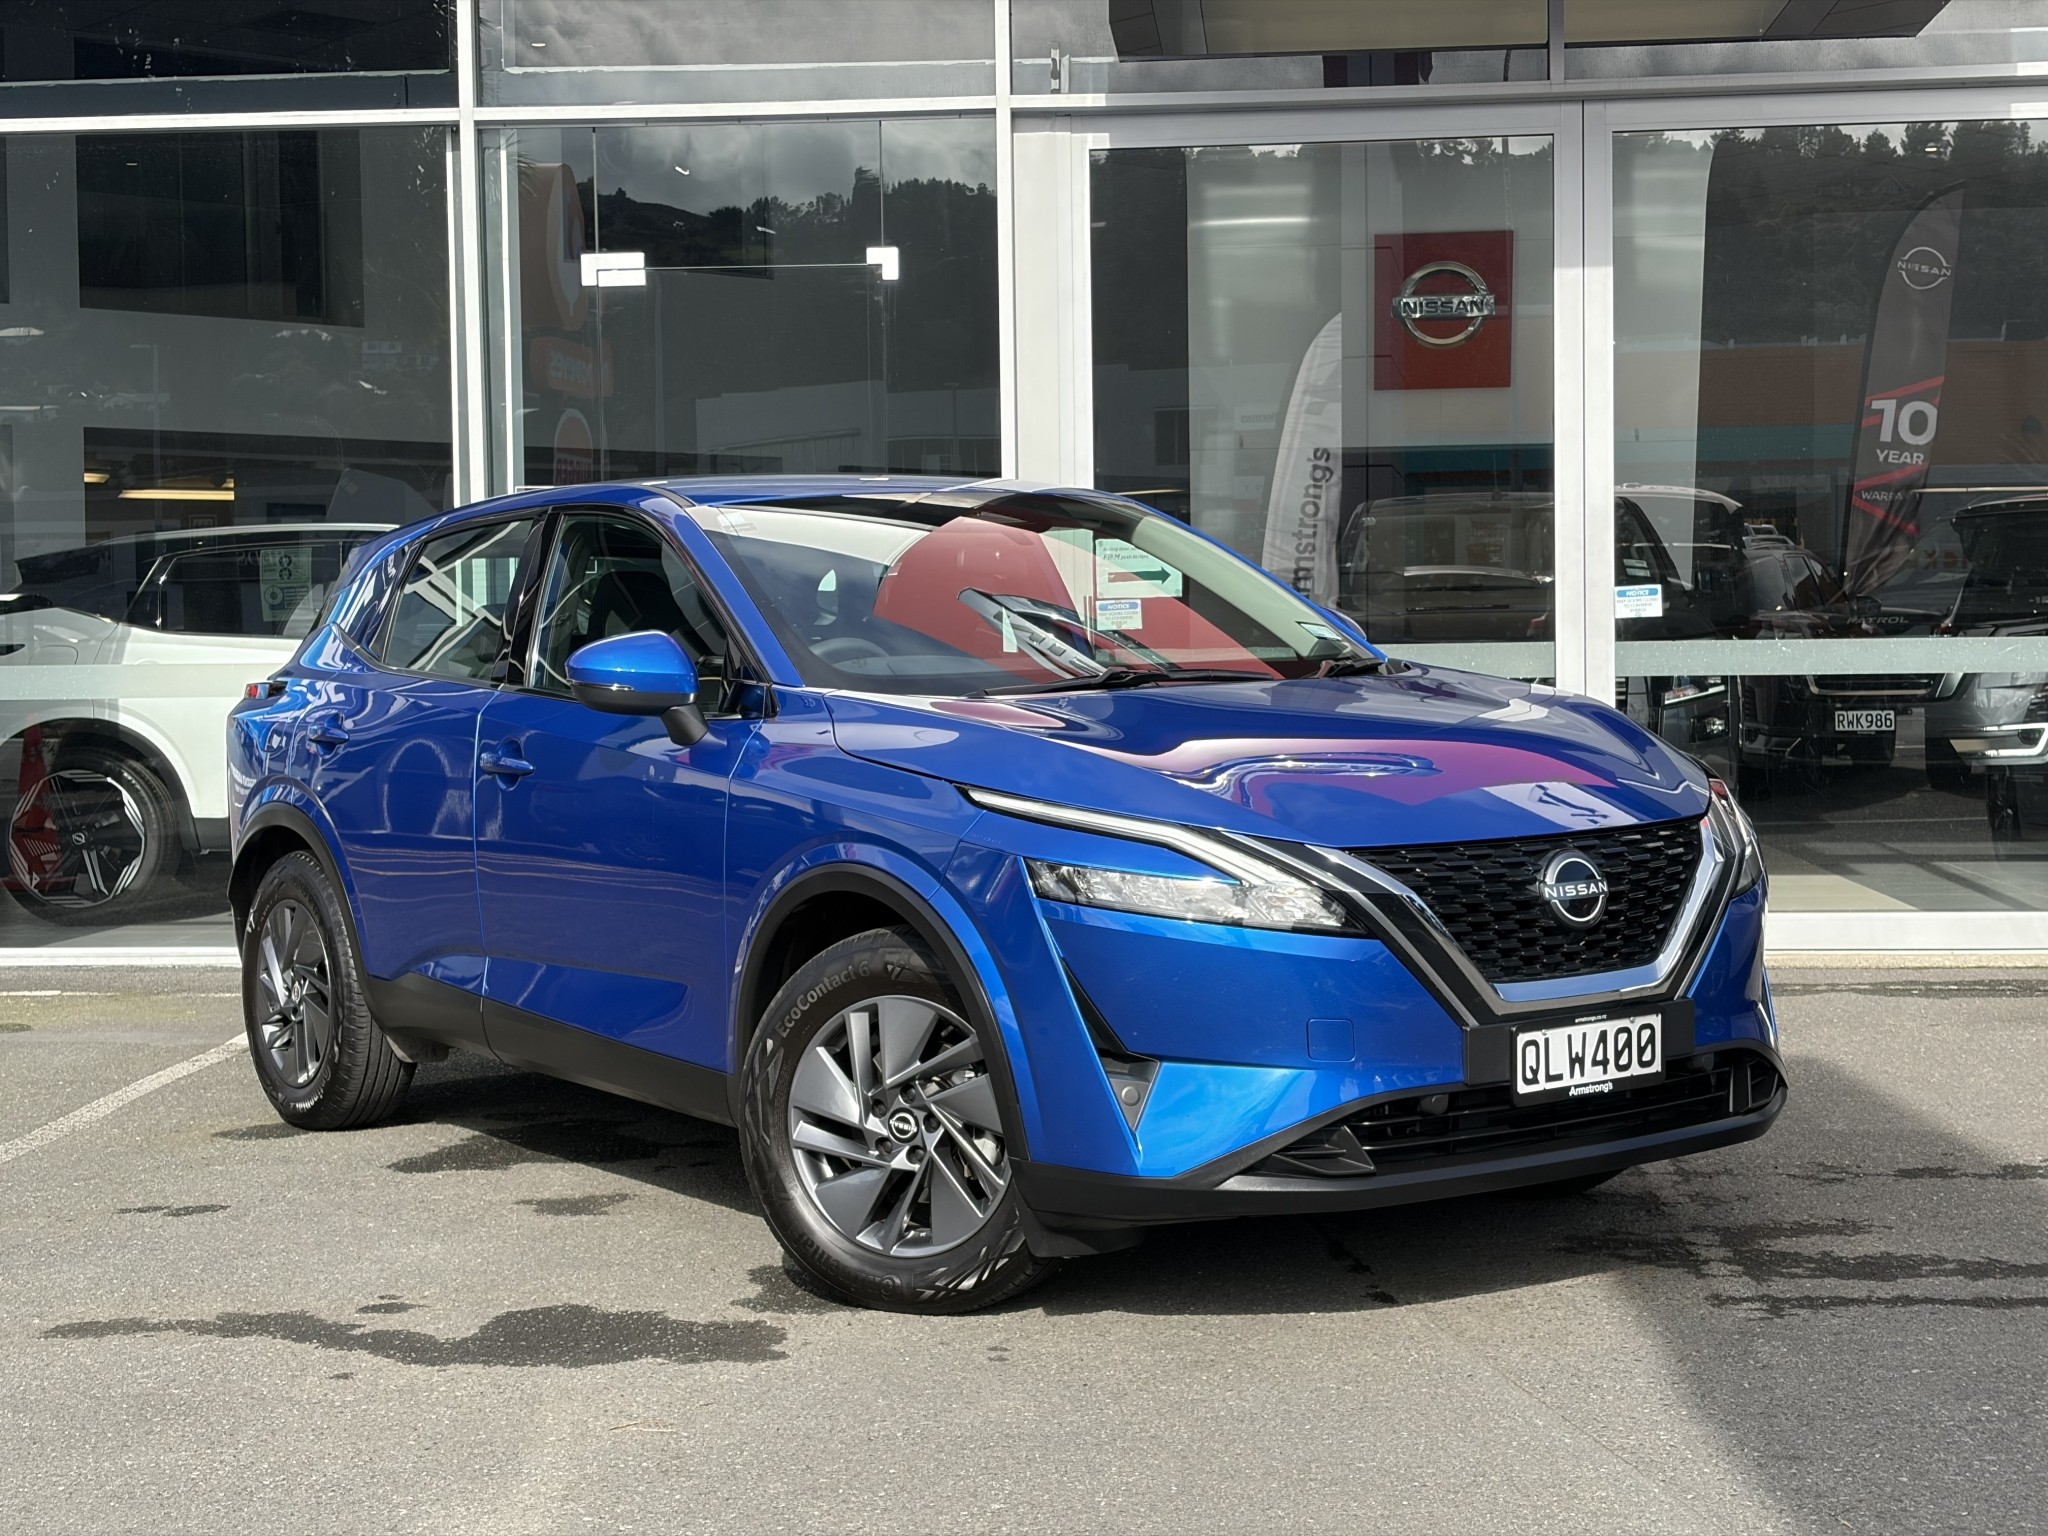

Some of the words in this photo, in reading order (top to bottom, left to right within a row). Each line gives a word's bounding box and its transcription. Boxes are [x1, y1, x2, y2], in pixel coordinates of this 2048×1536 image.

[1897, 260, 1952, 276] NISSAN
[1402, 299, 1485, 315] NISSAN
[1870, 399, 1938, 446] 10
[1876, 449, 1924, 465] YEAR
[1626, 589, 1649, 597] NOTICE
[1846, 616, 1909, 625] PATROL
[1836, 712, 1893, 729] RWK986
[1544, 880, 1608, 898] NISSAN
[774, 964, 857, 1039] EcoContact
[858, 960, 871, 977] 6
[1521, 1022, 1656, 1086] QLW400
[1569, 1081, 1613, 1097] Armstrong's
